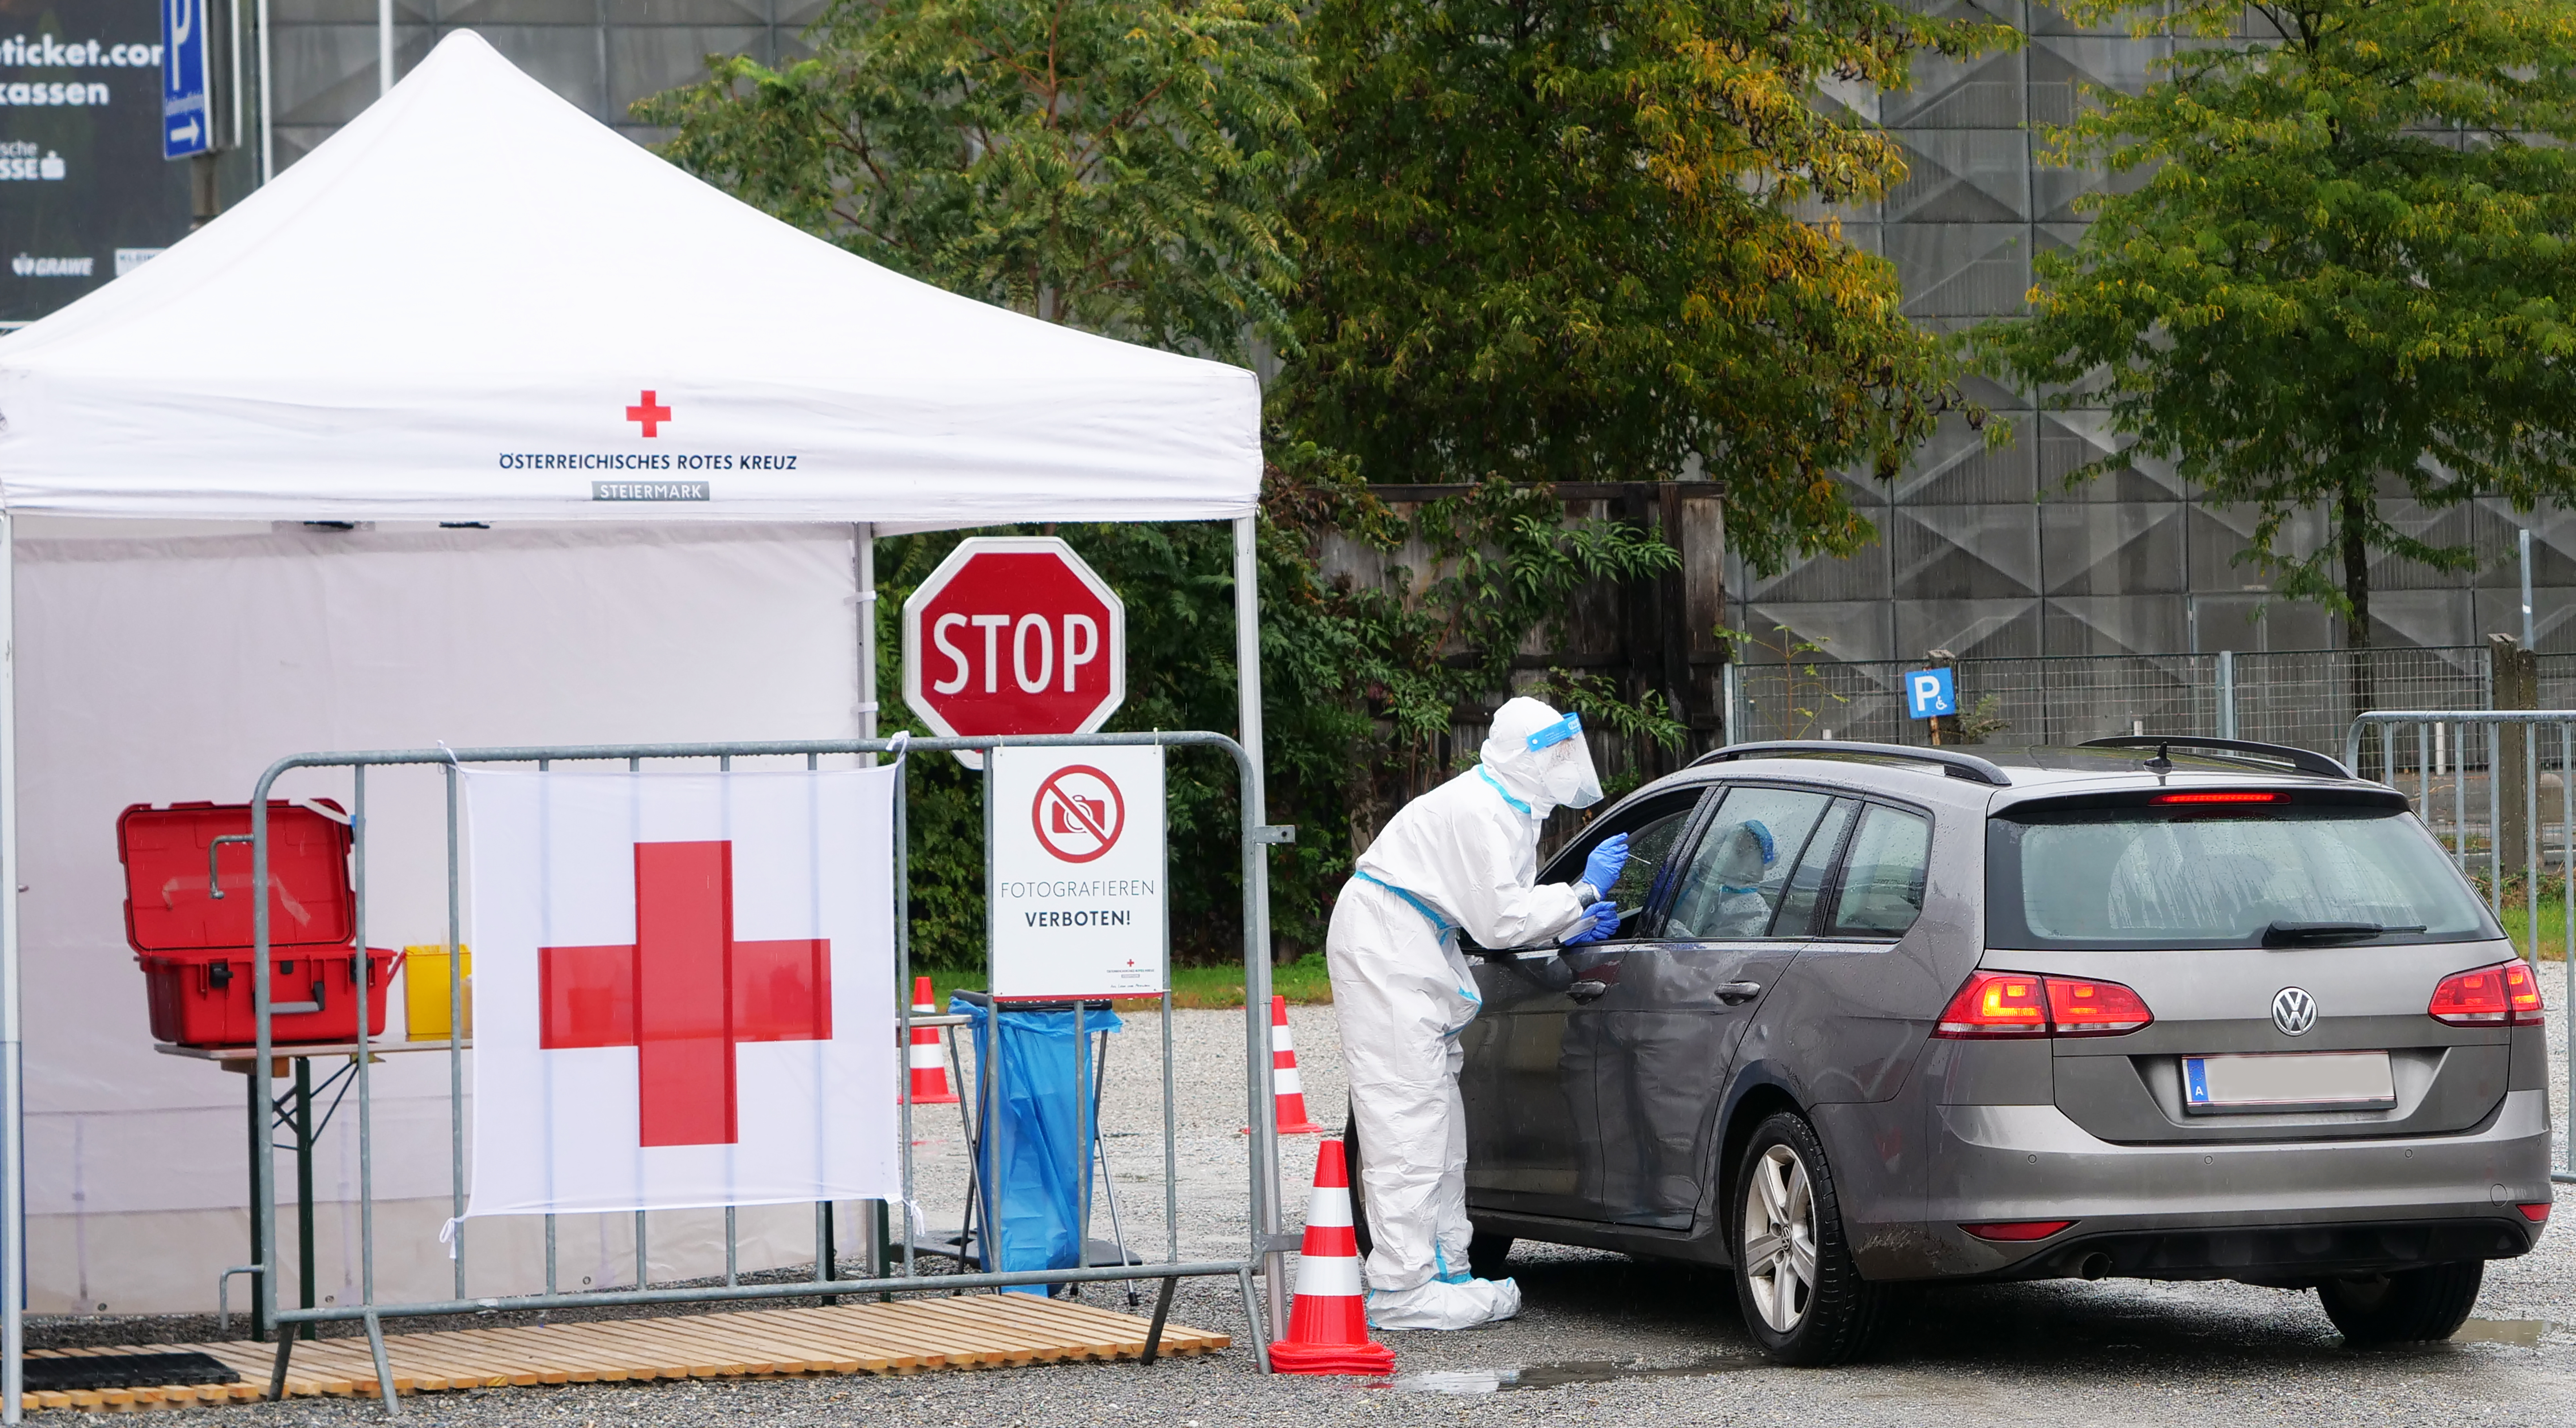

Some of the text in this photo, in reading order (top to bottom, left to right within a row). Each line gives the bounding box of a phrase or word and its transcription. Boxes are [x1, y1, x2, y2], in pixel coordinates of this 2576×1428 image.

[500, 453, 797, 470] ÖSTERREICHISCHES ROTES KREUZ
[600, 484, 701, 498] STEIERMARK
[933, 613, 1098, 694] STOP
[1914, 676, 1940, 711] P
[1001, 880, 1154, 898] FOTOGRAFIEREN
[1025, 910, 1130, 927] VERBOTEN!
[2195, 1086, 2204, 1096] A
